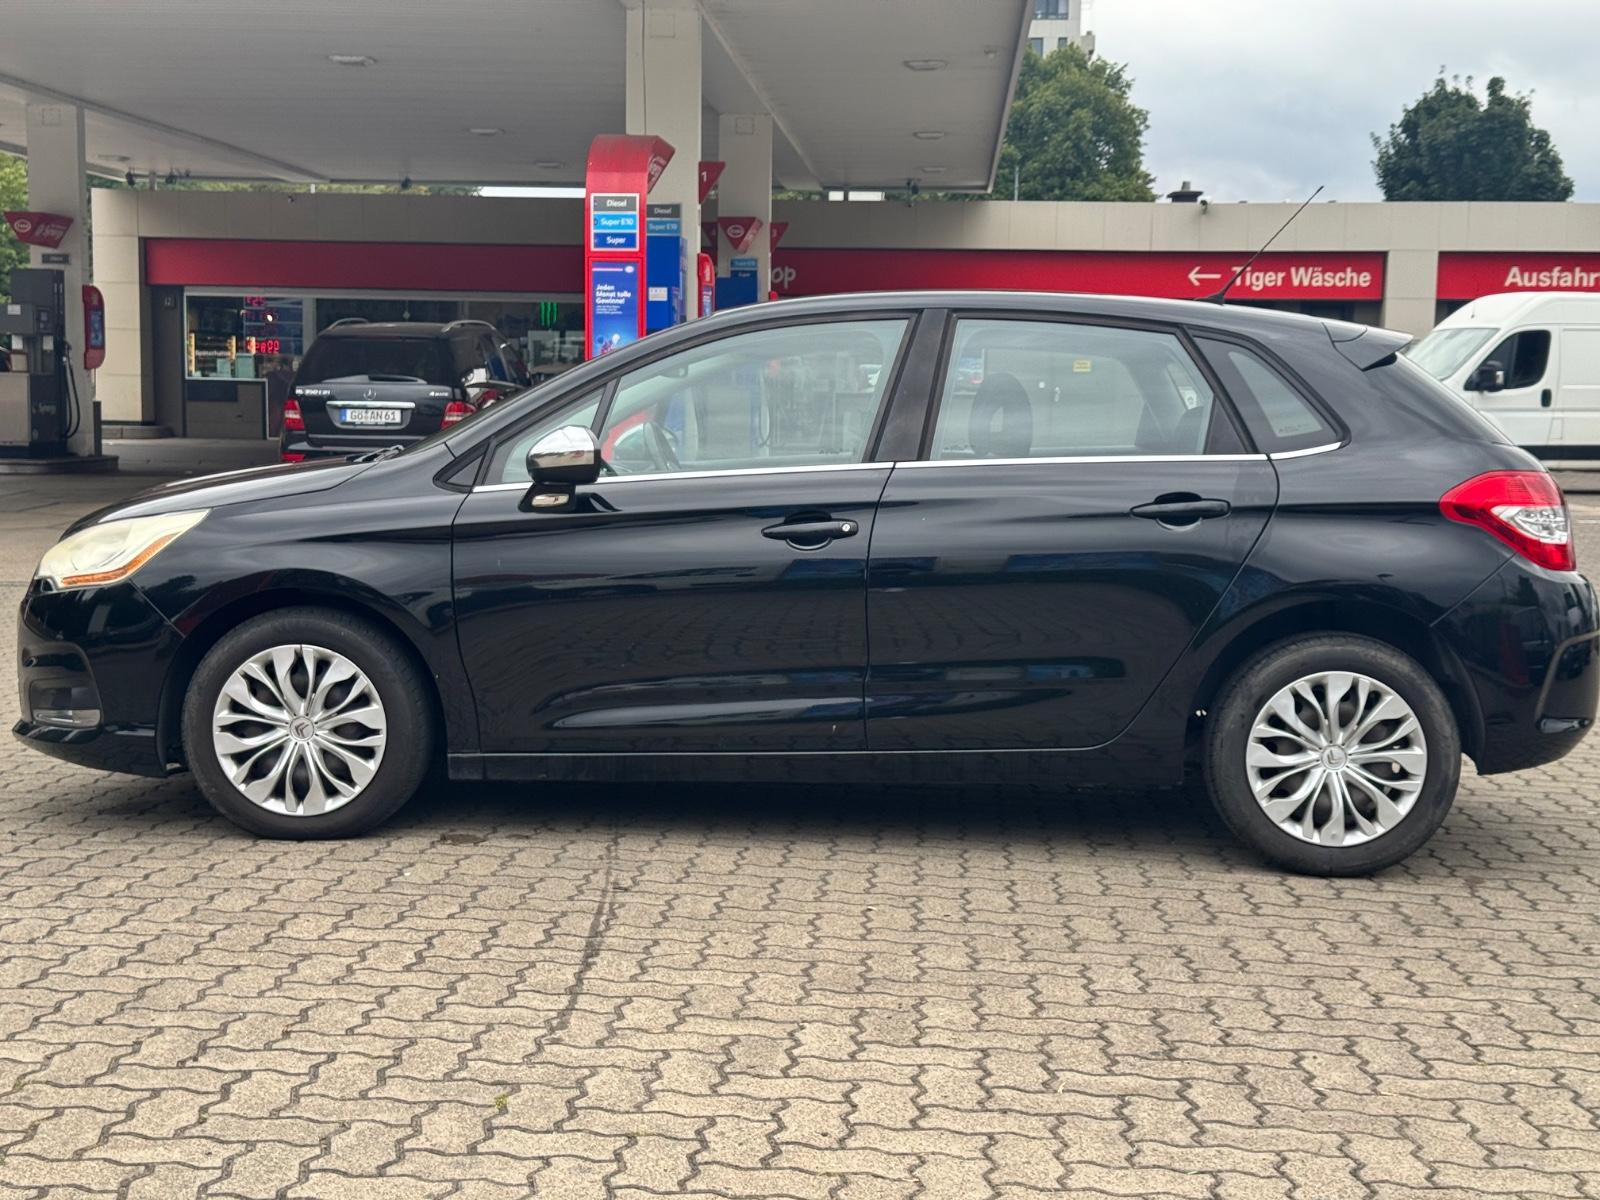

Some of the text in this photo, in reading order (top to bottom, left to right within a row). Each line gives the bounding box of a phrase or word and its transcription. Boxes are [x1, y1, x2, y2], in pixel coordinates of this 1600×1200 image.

[701, 171, 707, 182] 1
[606, 199, 627, 207] Diesel
[600, 218, 634, 226] Super E10
[606, 236, 627, 245] Super
[771, 266, 797, 289] op
[1231, 266, 1372, 291] Tiger Wäsche
[1504, 265, 1600, 287] Ausfahr
[369, 410, 383, 421] AN
[384, 410, 396, 421] 61
